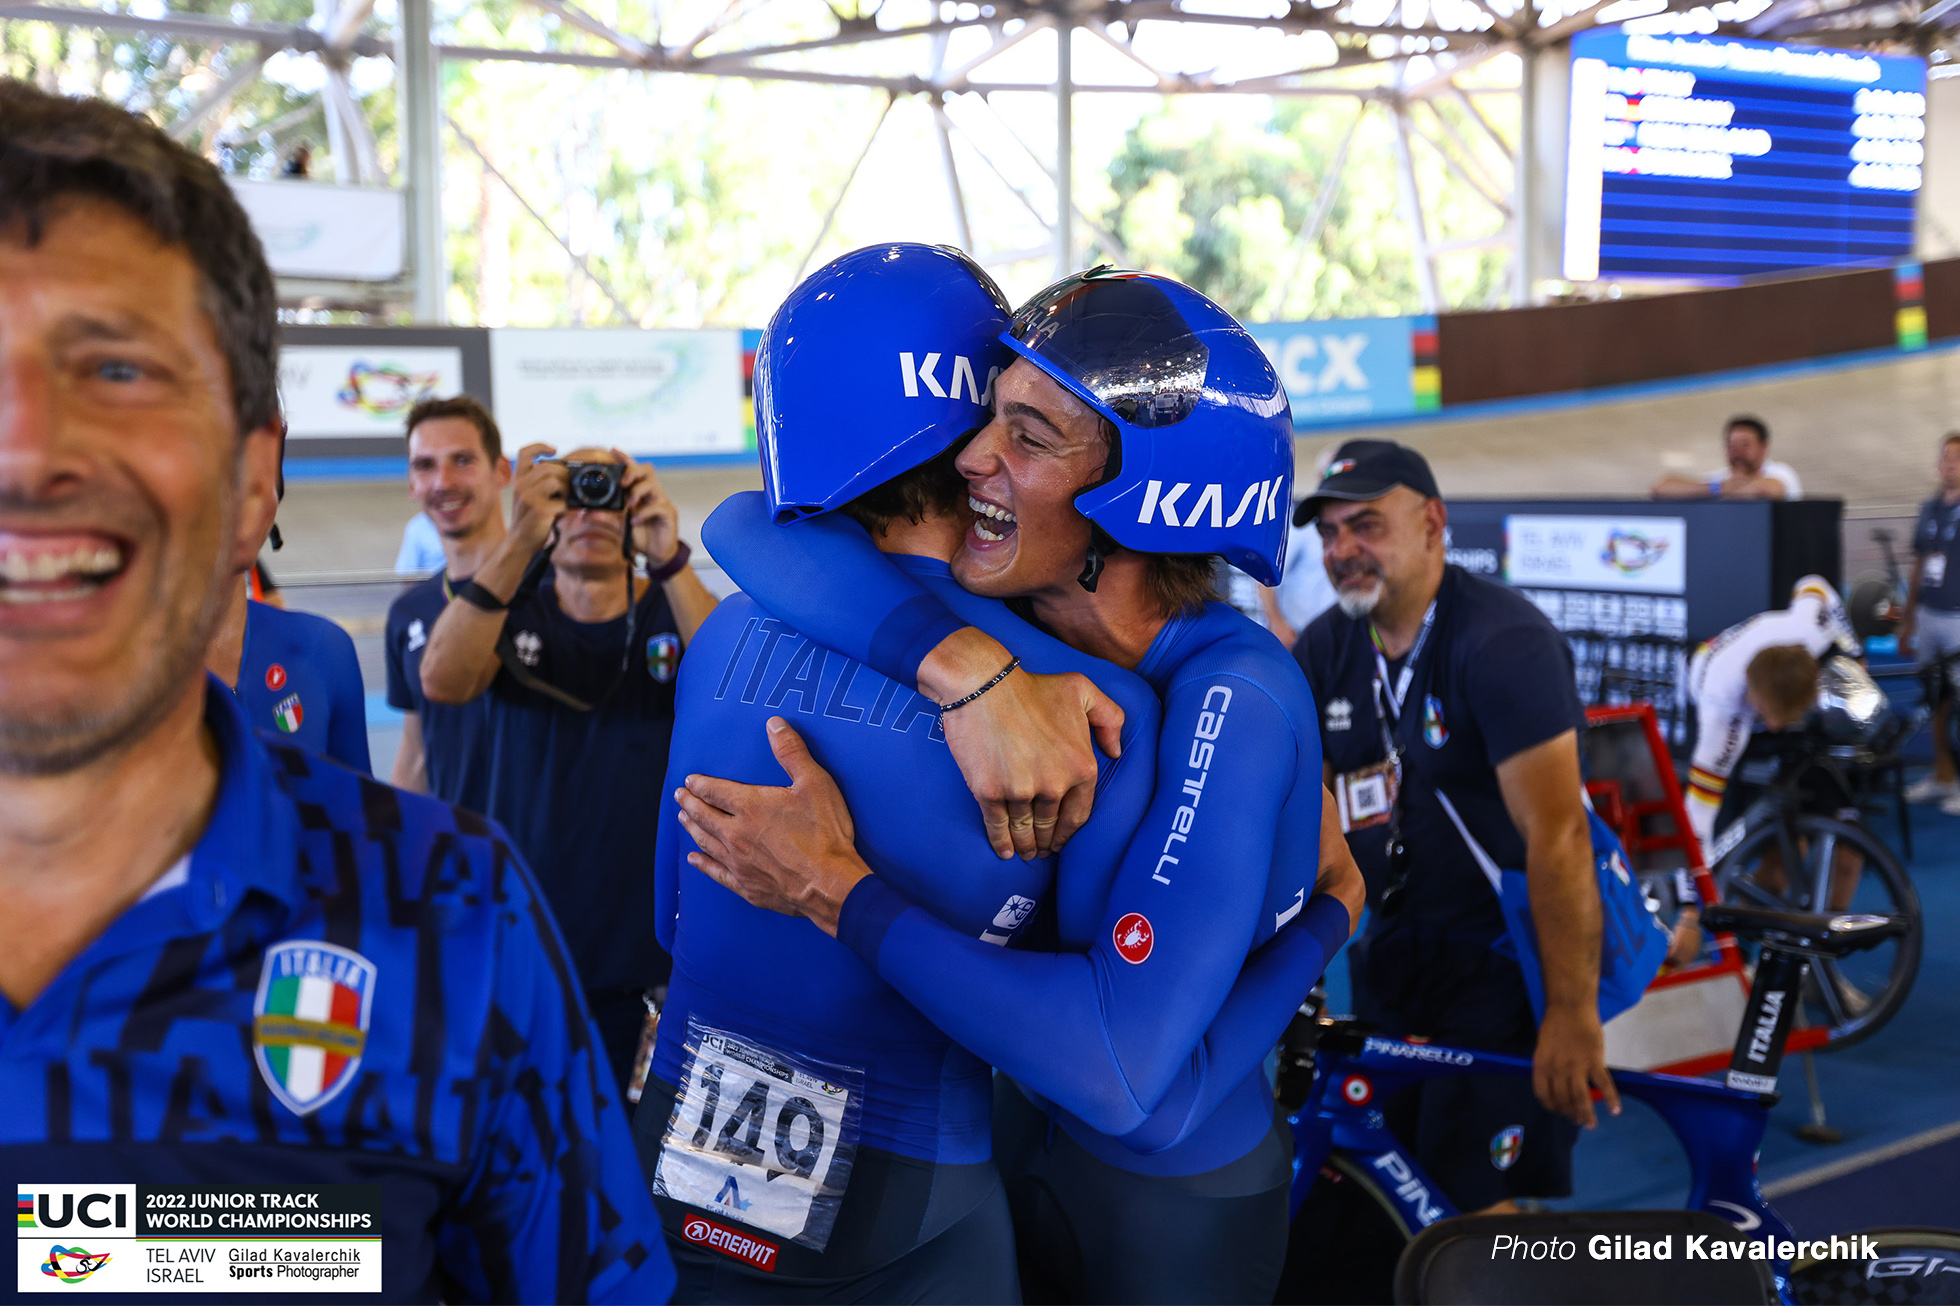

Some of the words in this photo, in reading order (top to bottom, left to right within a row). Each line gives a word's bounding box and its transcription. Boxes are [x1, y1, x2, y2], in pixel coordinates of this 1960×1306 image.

[899, 352, 1004, 406] KAS
[1261, 334, 1369, 394] CX
[1137, 474, 1284, 528] KASK
[714, 616, 946, 744] ITALIA
[279, 949, 363, 989] ITALIA
[1747, 990, 1787, 1064] ITALIA
[708, 1228, 775, 1265] ENERVIT
